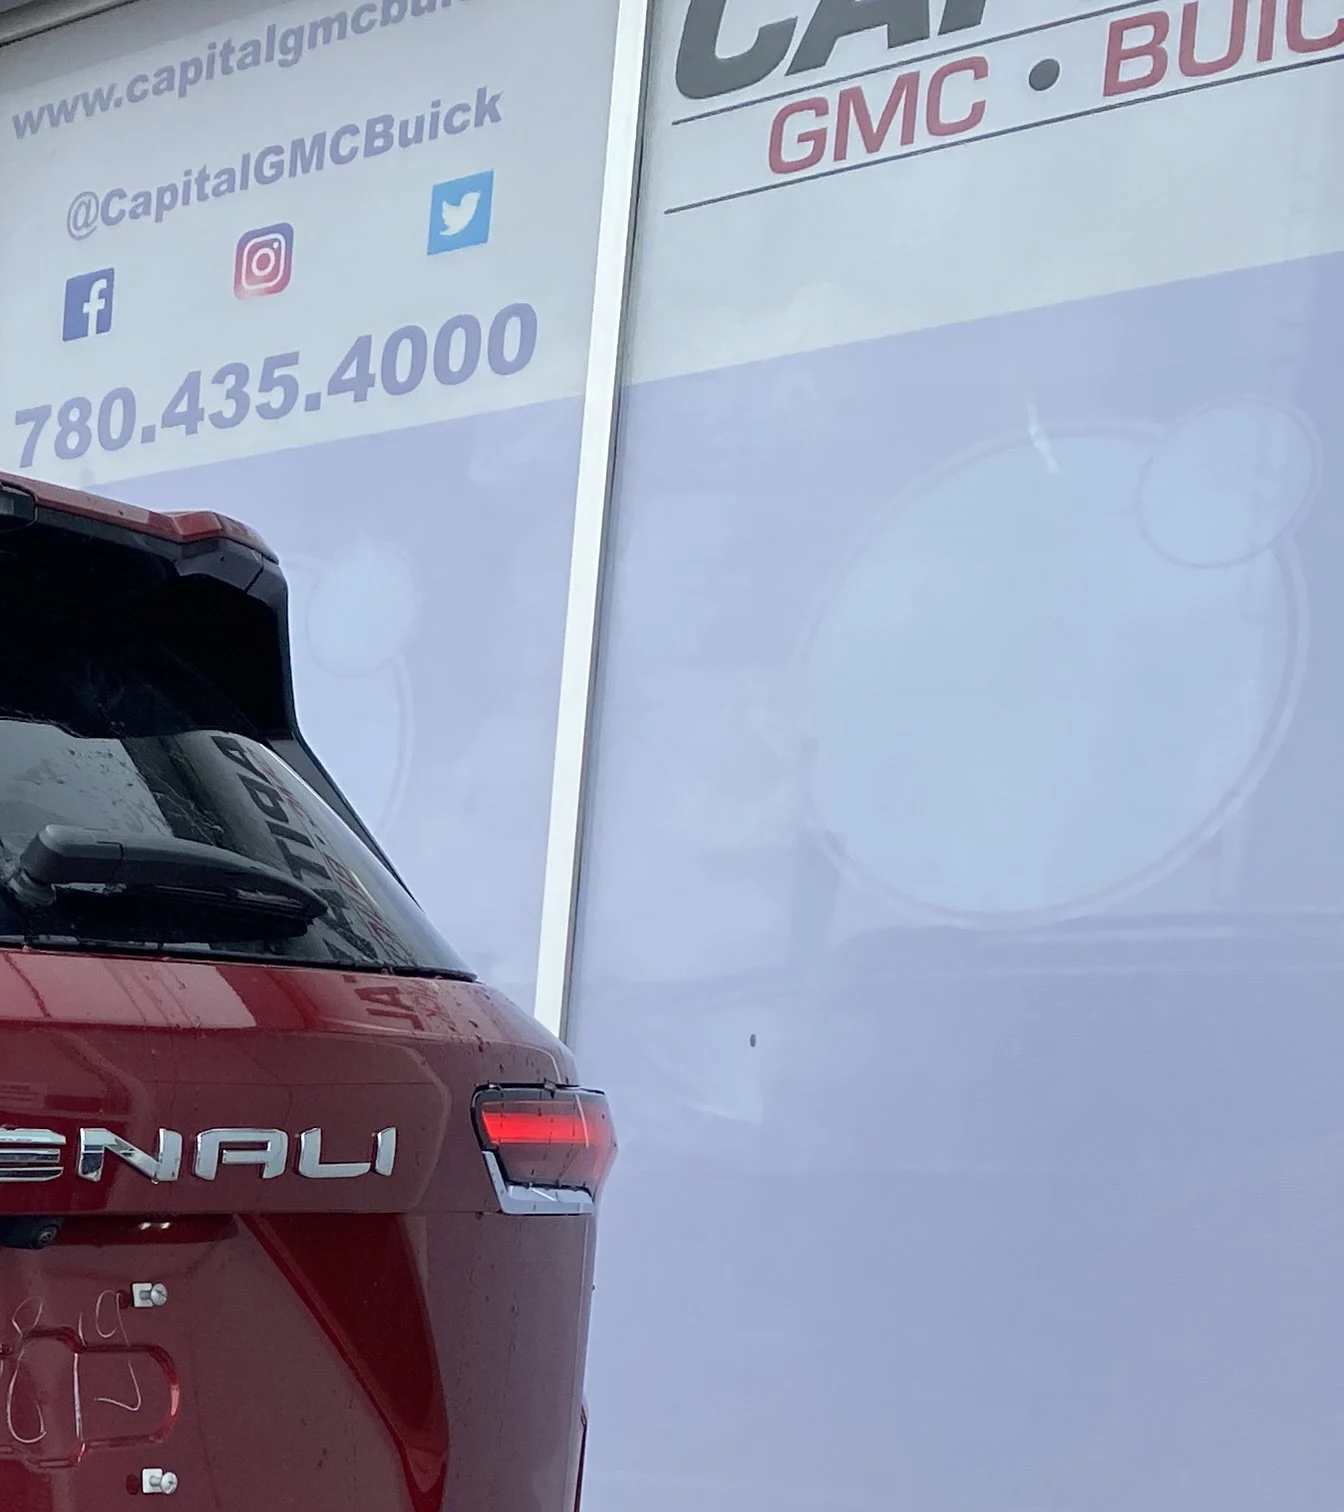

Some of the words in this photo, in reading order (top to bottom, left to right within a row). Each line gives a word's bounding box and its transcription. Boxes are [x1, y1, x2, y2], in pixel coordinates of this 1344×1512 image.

[66, 87, 504, 239] @CapitalGMCBuick
[768, 56, 989, 175] GMC
[15, 303, 538, 468] 780.435.4000
